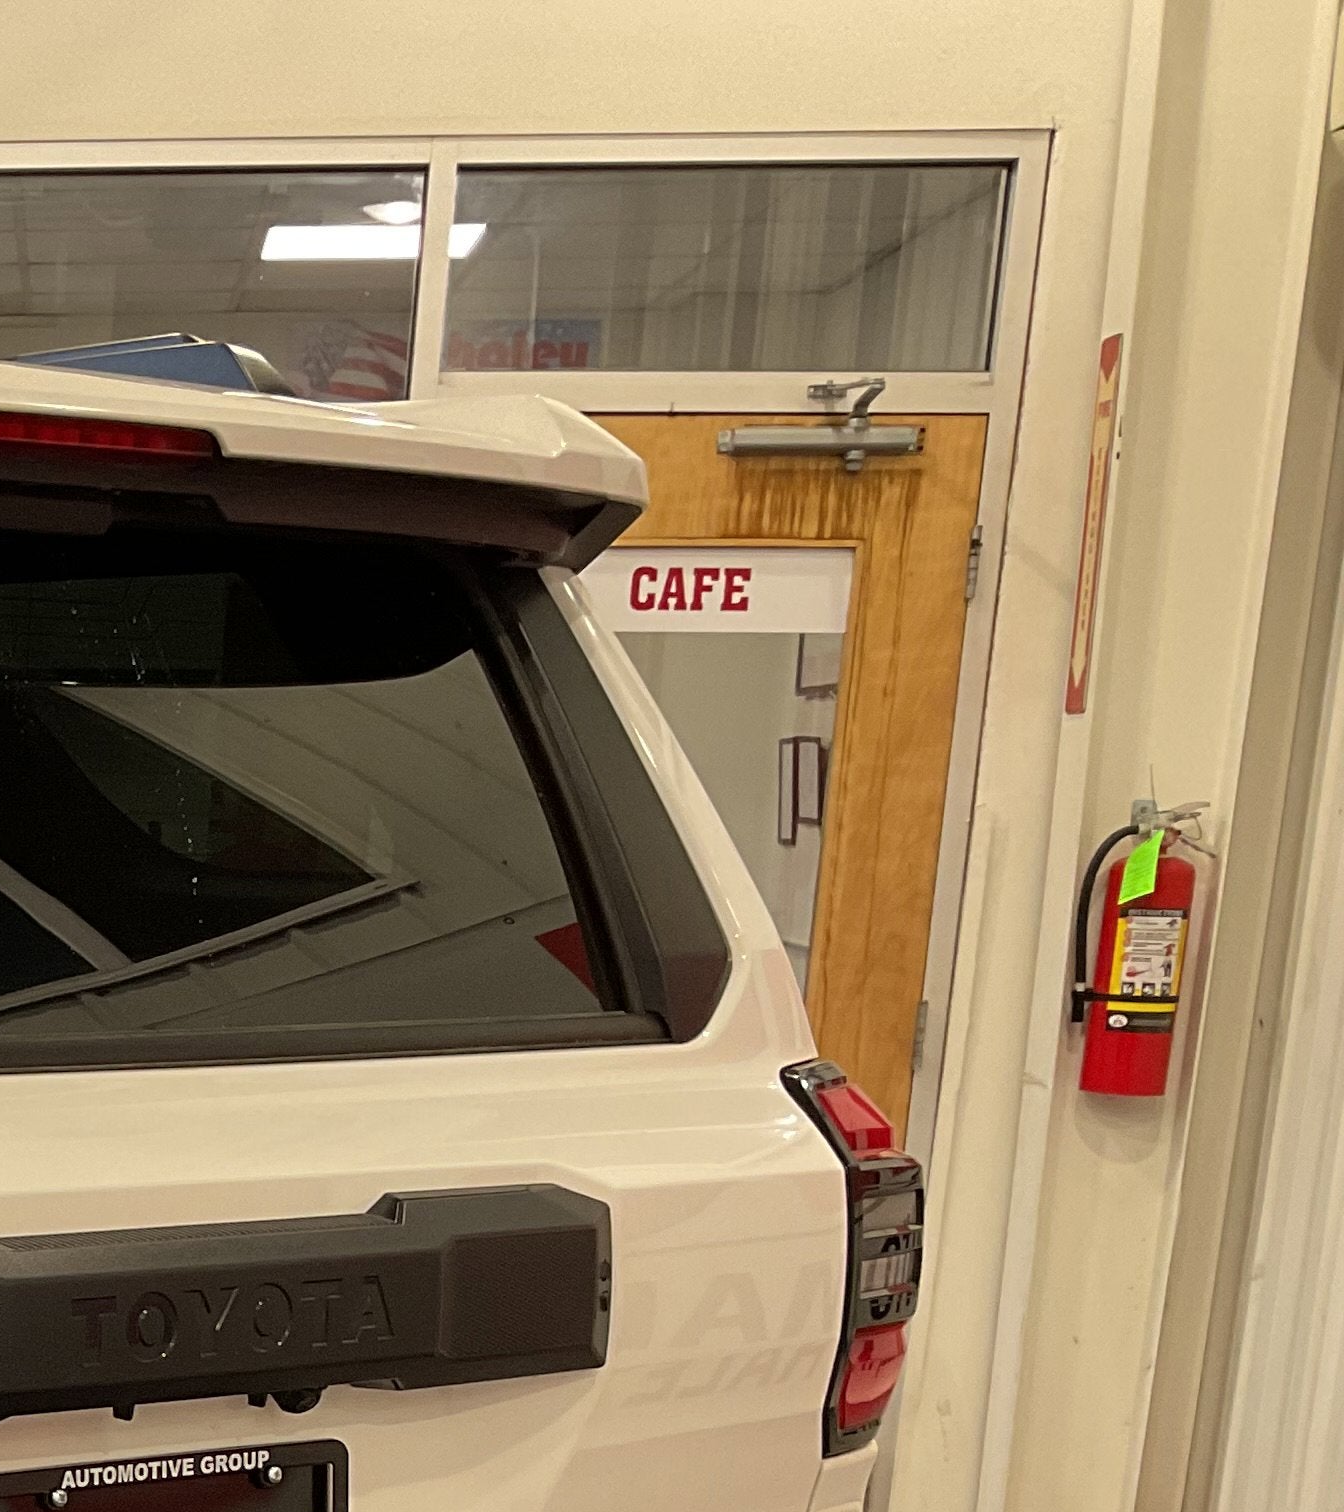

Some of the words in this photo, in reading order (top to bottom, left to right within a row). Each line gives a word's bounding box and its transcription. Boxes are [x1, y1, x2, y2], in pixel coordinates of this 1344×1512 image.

[630, 566, 753, 612] CAFE
[71, 1274, 395, 1369] TOYOTA
[61, 1457, 196, 1490] AUTOMOTIVE
[200, 1448, 271, 1477] GROUP
